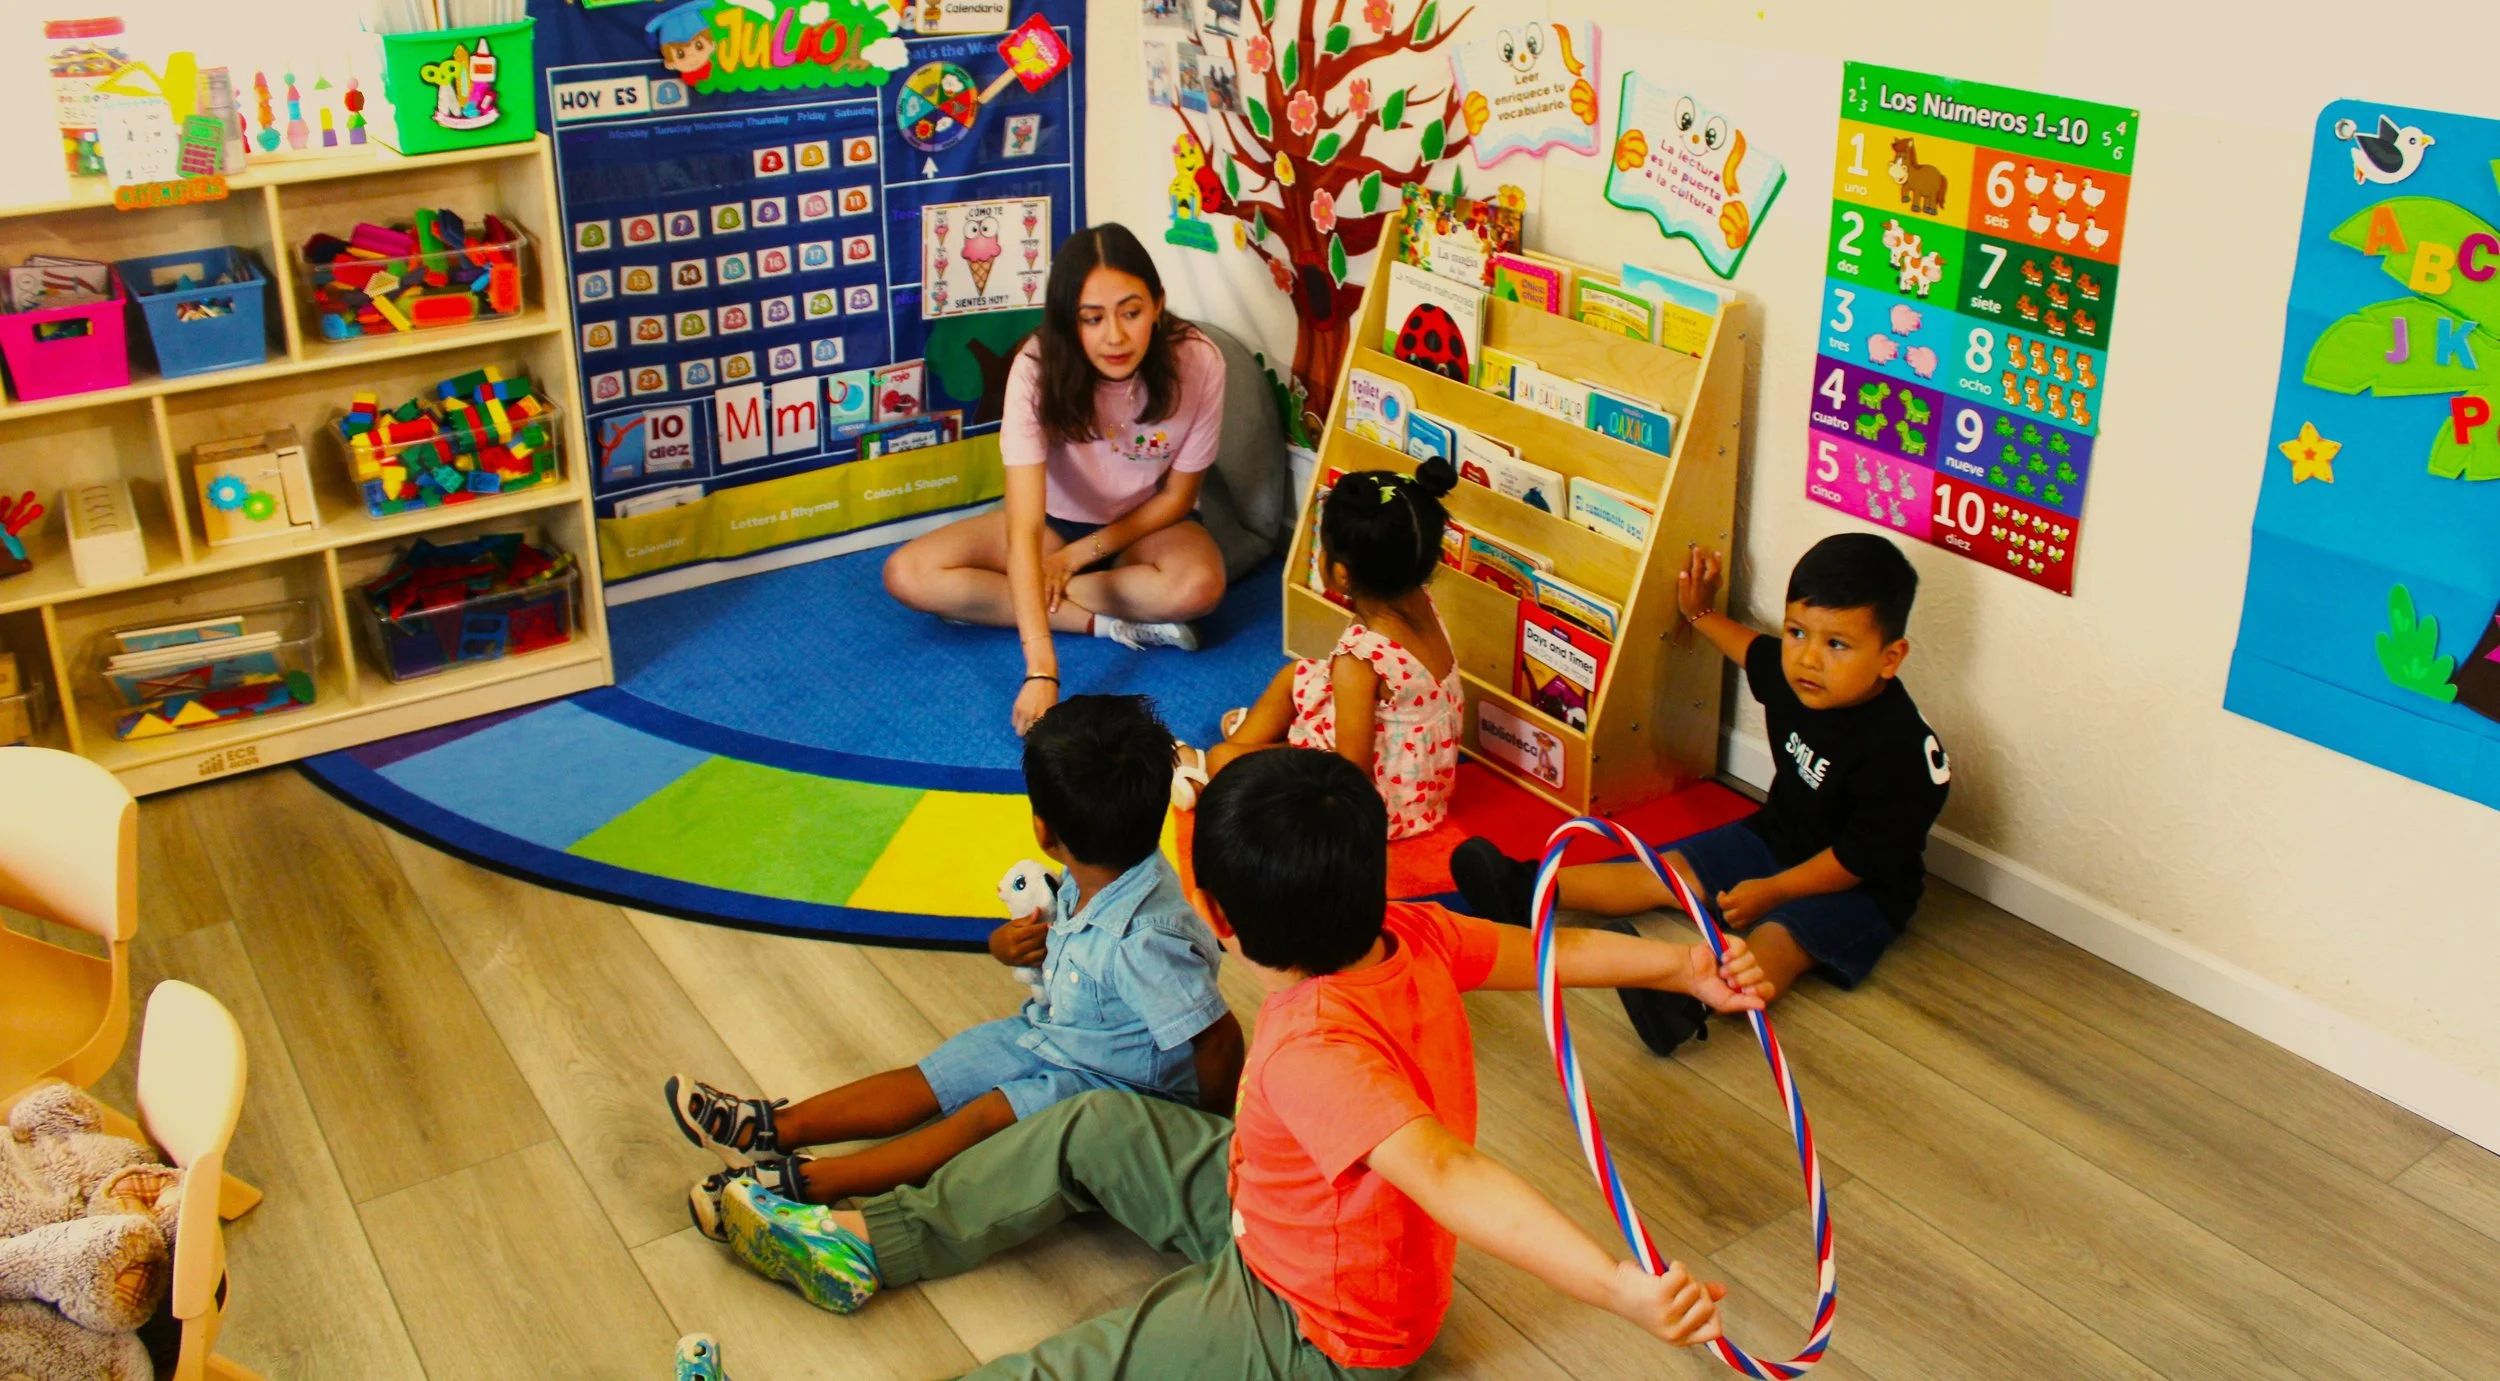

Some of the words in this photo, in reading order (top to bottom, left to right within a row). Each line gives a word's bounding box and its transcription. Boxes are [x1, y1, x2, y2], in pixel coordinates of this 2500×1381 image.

[945, 2, 1003, 13] Calendario
[1514, 71, 1540, 86] Leer
[1859, 77, 1867, 90] 1
[560, 90, 601, 110] HOY
[614, 87, 637, 105] ES
[1495, 87, 1550, 107] enriquece
[1552, 84, 1566, 96] tu
[1848, 88, 1856, 103] 2
[1859, 99, 1868, 113] 3
[747, 115, 788, 127] Thursday
[797, 110, 827, 122] Friday
[834, 106, 876, 118] Saturday
[1497, 100, 1567, 121] vocabulario.
[1879, 84, 1917, 113] Los
[1922, 92, 2028, 135] Números
[2034, 113, 2088, 145] 1-10
[2102, 131, 2112, 147] 5
[2116, 121, 2127, 136] 4
[1660, 139, 1675, 153] La
[1678, 150, 1721, 183] lectura
[1847, 133, 1869, 177] 1
[2113, 146, 2123, 160] 6
[1645, 169, 1653, 179] a
[1655, 173, 1667, 189] la
[1650, 154, 1664, 166] es
[1667, 161, 1678, 176] la
[1681, 172, 1721, 201] puerta
[1844, 183, 1867, 195] uno
[1986, 161, 2015, 208] 6
[808, 200, 824, 212] 10
[848, 196, 861, 207] 11
[993, 206, 1004, 216] TE
[1985, 213, 2009, 229] seis
[1838, 211, 1864, 256] 2
[2363, 206, 2409, 256] A
[2408, 241, 2457, 295] B
[2457, 232, 2500, 282] C
[632, 275, 647, 287] 13
[681, 269, 697, 281] 14
[726, 263, 739, 274] 15
[767, 256, 783, 268] 16
[807, 247, 823, 260] 17
[1837, 259, 1859, 275] dos
[1978, 243, 2008, 289] 7
[955, 296, 986, 309] SIENTES
[1830, 288, 1856, 333] 3
[1971, 296, 2002, 314] siete
[593, 328, 609, 342] 19
[640, 323, 658, 335] 20
[686, 319, 700, 331] 21
[728, 312, 743, 325] 22
[770, 304, 785, 317] 23
[811, 296, 829, 310] 24
[853, 293, 869, 305] 25
[1829, 336, 1850, 353] tres
[1965, 328, 1995, 374] 8
[2385, 317, 2410, 364] J
[2436, 317, 2479, 370] K
[727, 359, 746, 373] 29
[890, 371, 910, 383] rojo
[1352, 380, 1379, 399] Toilet
[1819, 368, 1846, 410] 4
[1959, 377, 1992, 396] ocho
[1356, 396, 1376, 412] Time
[1519, 380, 1535, 400] SAN
[1539, 388, 1582, 421] SALVADOR
[652, 414, 683, 440] 10
[726, 397, 762, 443] M
[777, 396, 816, 437] m
[1610, 411, 1653, 447] OAXACA
[1812, 411, 1850, 432] cuatro
[1955, 408, 1983, 453] 9
[2449, 395, 2491, 445] P
[649, 444, 689, 459] diez
[1816, 439, 1839, 482] 5
[1945, 455, 1985, 478] nueve
[864, 483, 902, 501] Colors
[904, 481, 913, 493] &
[914, 473, 958, 493] Shapes
[1810, 483, 1842, 503] cinco
[731, 514, 779, 531] Letters
[780, 509, 789, 521] &
[790, 499, 839, 520] Rhymes
[1932, 484, 1986, 536] 10
[626, 534, 685, 559] Calendar
[1945, 532, 1972, 552] diez
[1527, 627, 1547, 648] Days
[1549, 643, 1567, 658] and
[1569, 651, 1593, 674] Times
[1481, 717, 1538, 757] Biblioteca
